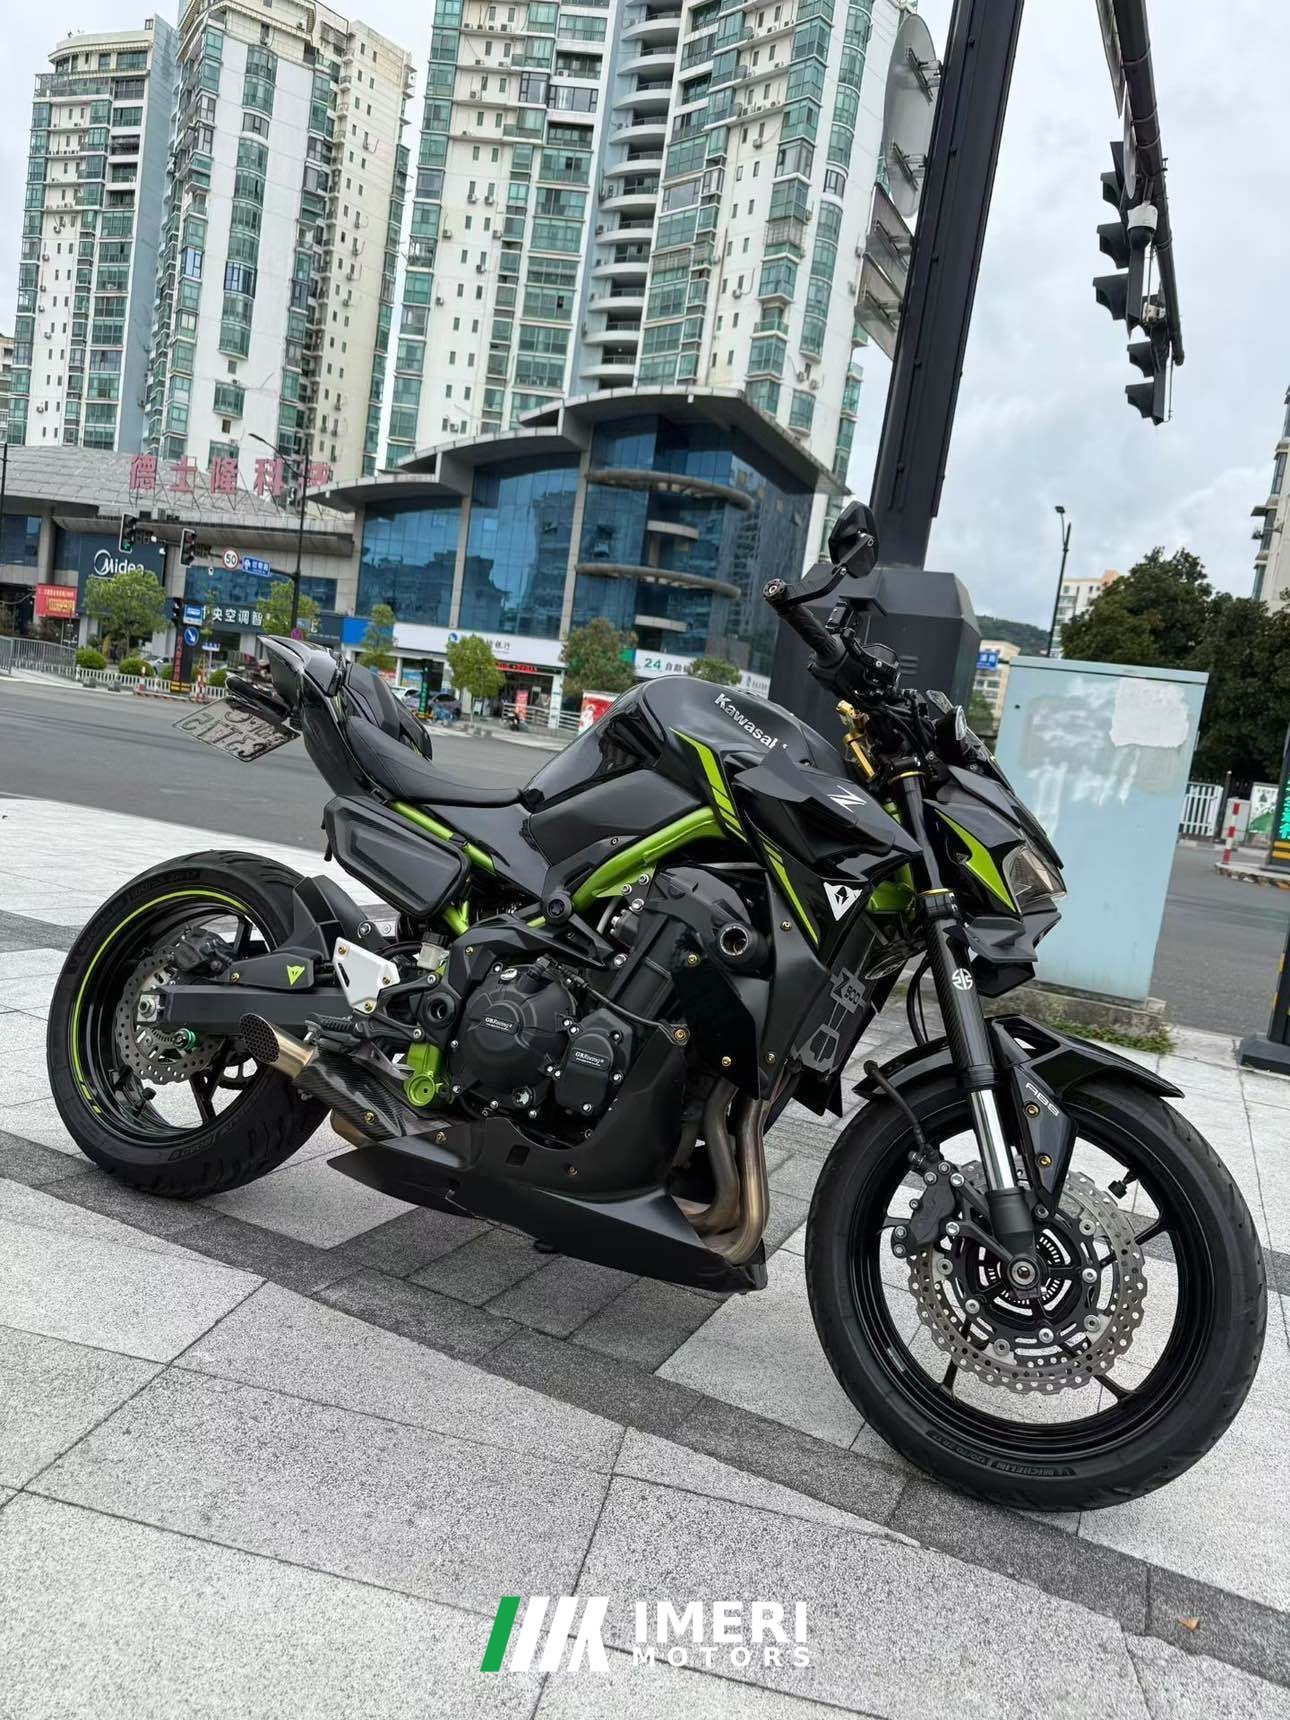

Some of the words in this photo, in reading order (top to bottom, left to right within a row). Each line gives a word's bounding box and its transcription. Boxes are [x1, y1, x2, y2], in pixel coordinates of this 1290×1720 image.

[94, 549, 145, 575] Midea
[226, 554, 236, 565] 50
[645, 658, 661, 670] 24
[1025, 1082, 1060, 1117] ABS
